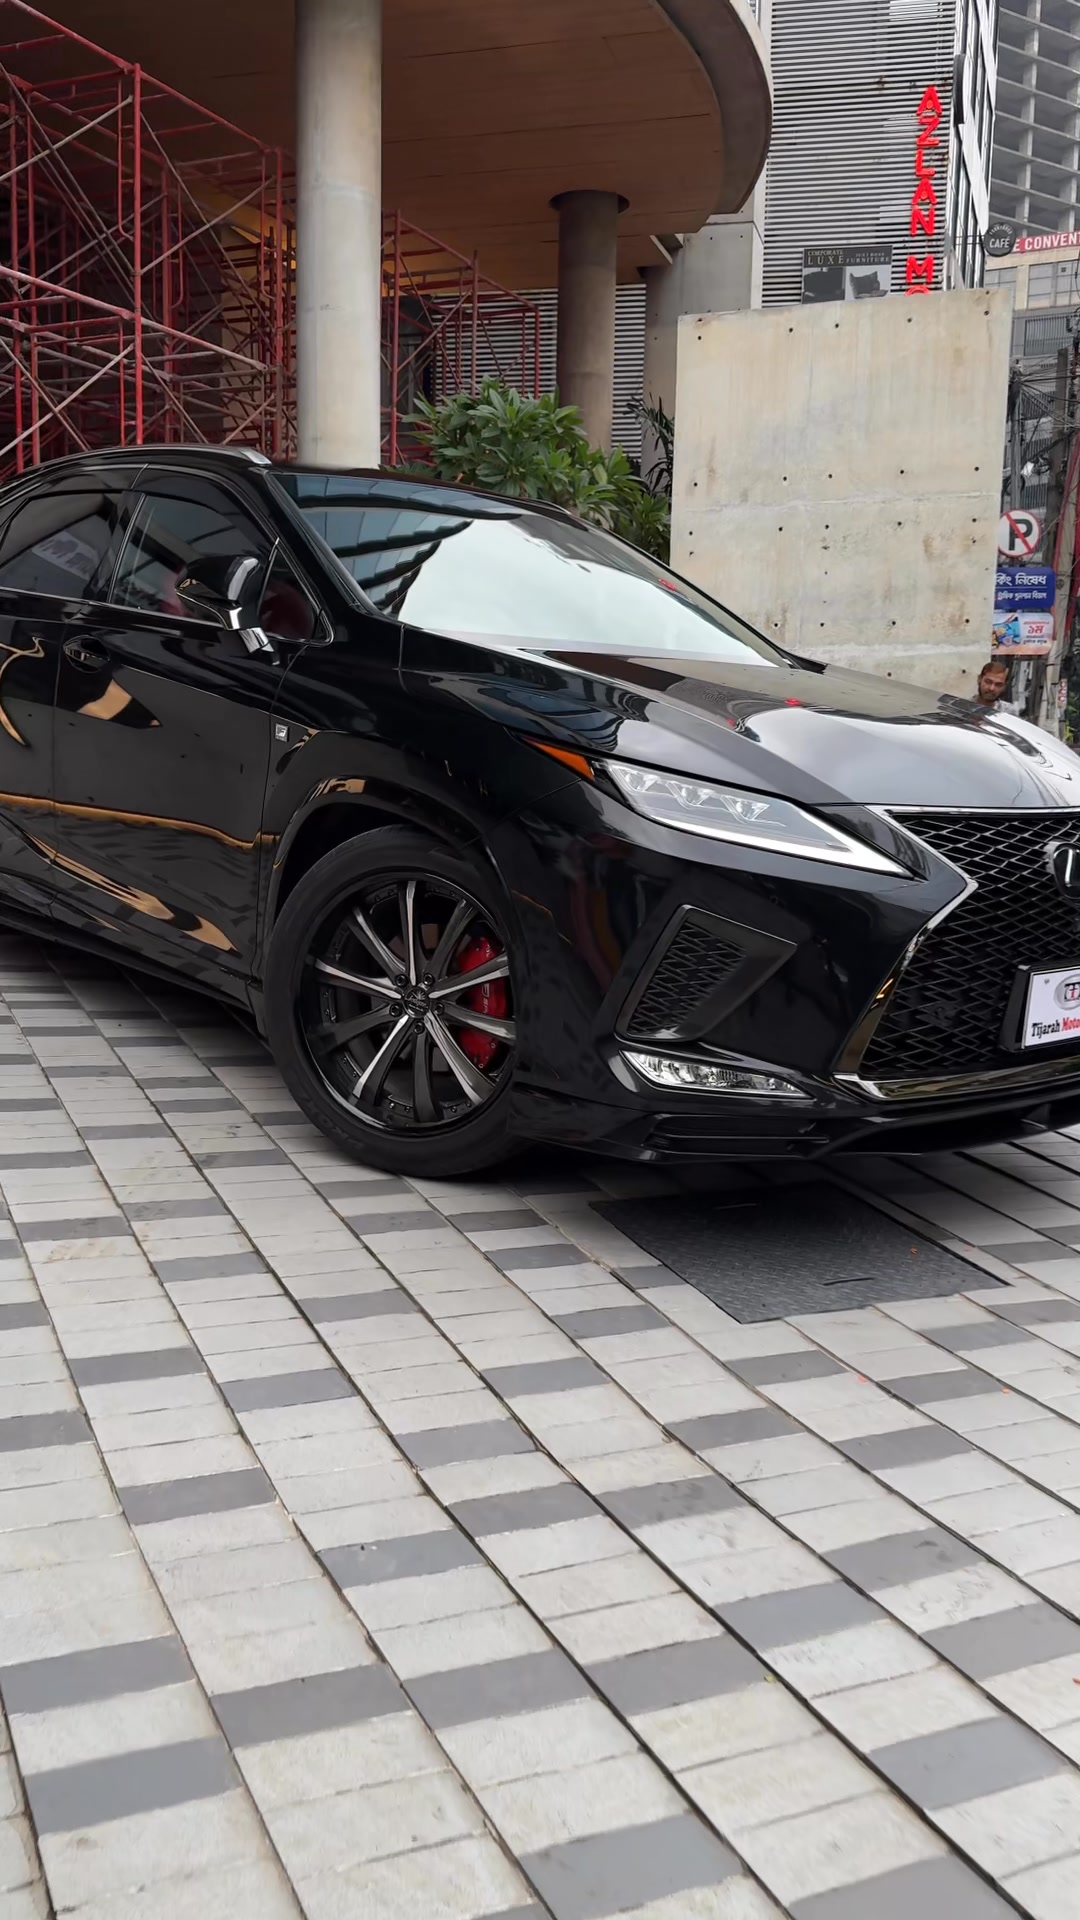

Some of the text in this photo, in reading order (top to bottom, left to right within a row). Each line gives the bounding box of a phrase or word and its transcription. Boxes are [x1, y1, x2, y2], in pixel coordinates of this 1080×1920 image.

[911, 86, 943, 236] AZLAN
[989, 236, 1010, 248] CAFÉ
[807, 255, 844, 265] LUXE
[1015, 572, 1047, 585] নিষেধ
[1031, 1020, 1060, 1039] Tijarah
